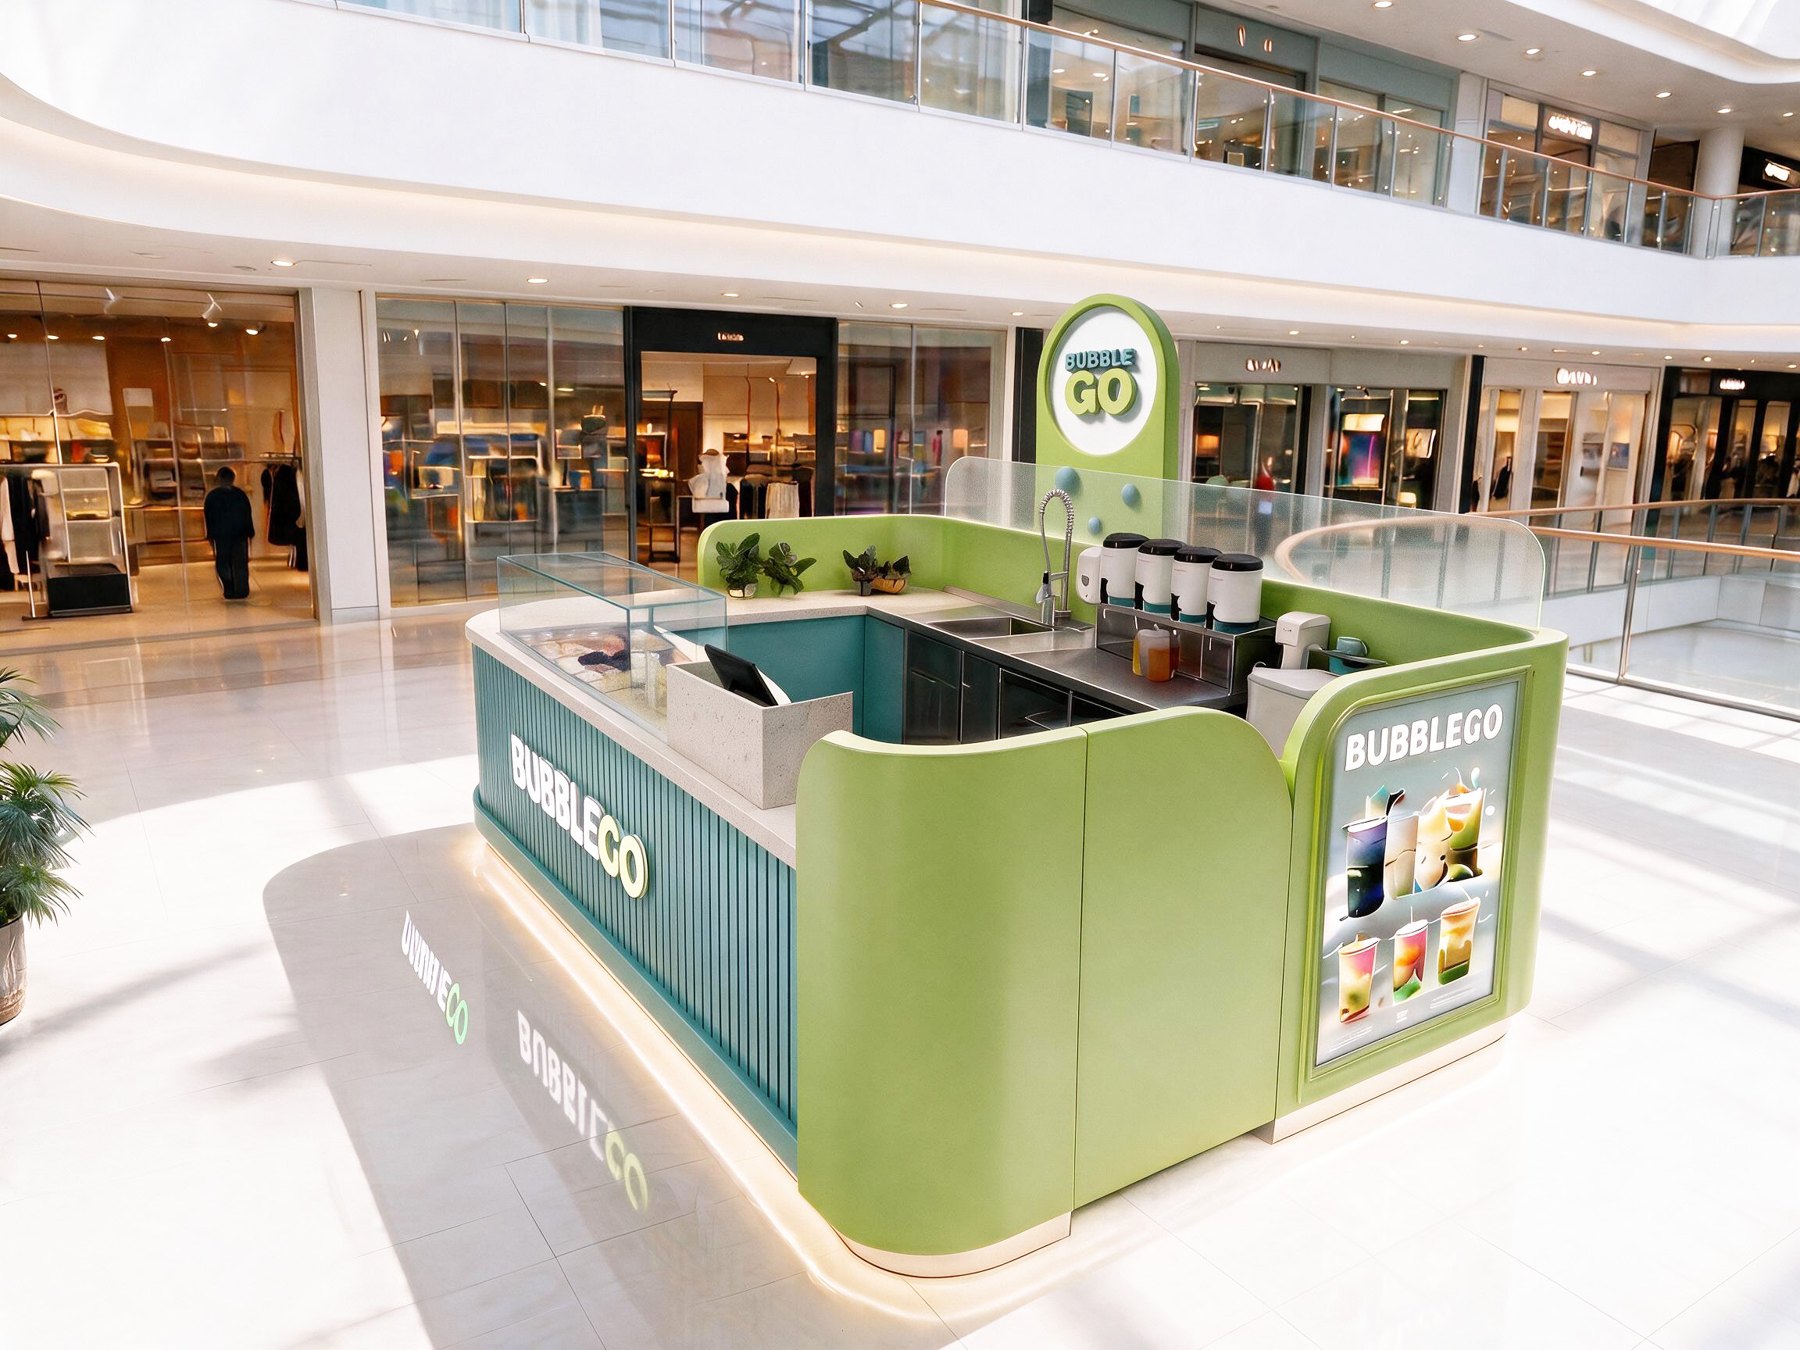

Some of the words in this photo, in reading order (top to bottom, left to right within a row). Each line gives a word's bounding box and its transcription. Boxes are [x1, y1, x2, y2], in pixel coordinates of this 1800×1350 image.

[1065, 347, 1136, 371] BUBBLE
[1065, 367, 1137, 416] GO
[1345, 704, 1503, 771] BUBBLEGO
